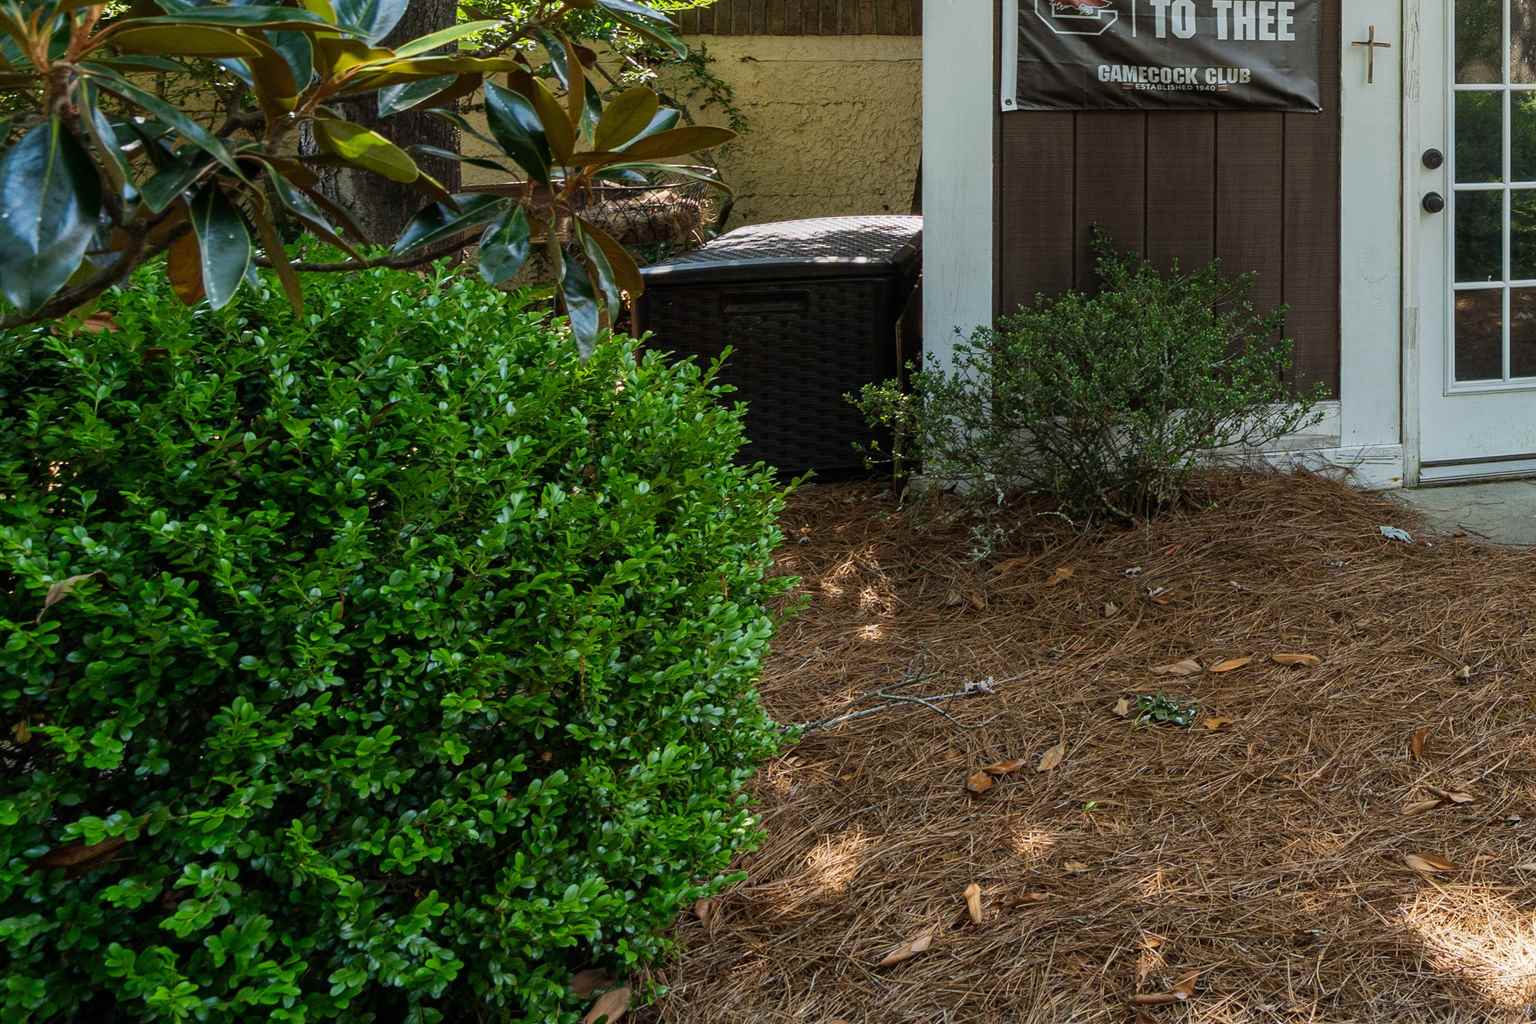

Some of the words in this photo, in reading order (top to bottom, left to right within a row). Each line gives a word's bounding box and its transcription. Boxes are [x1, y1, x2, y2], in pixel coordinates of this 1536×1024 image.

[1212, 0, 1296, 40] THEE
[1098, 64, 1198, 84] GAMECOCK
[1205, 67, 1250, 85] CLUB
[1135, 83, 1193, 91] ESTABLISHED
